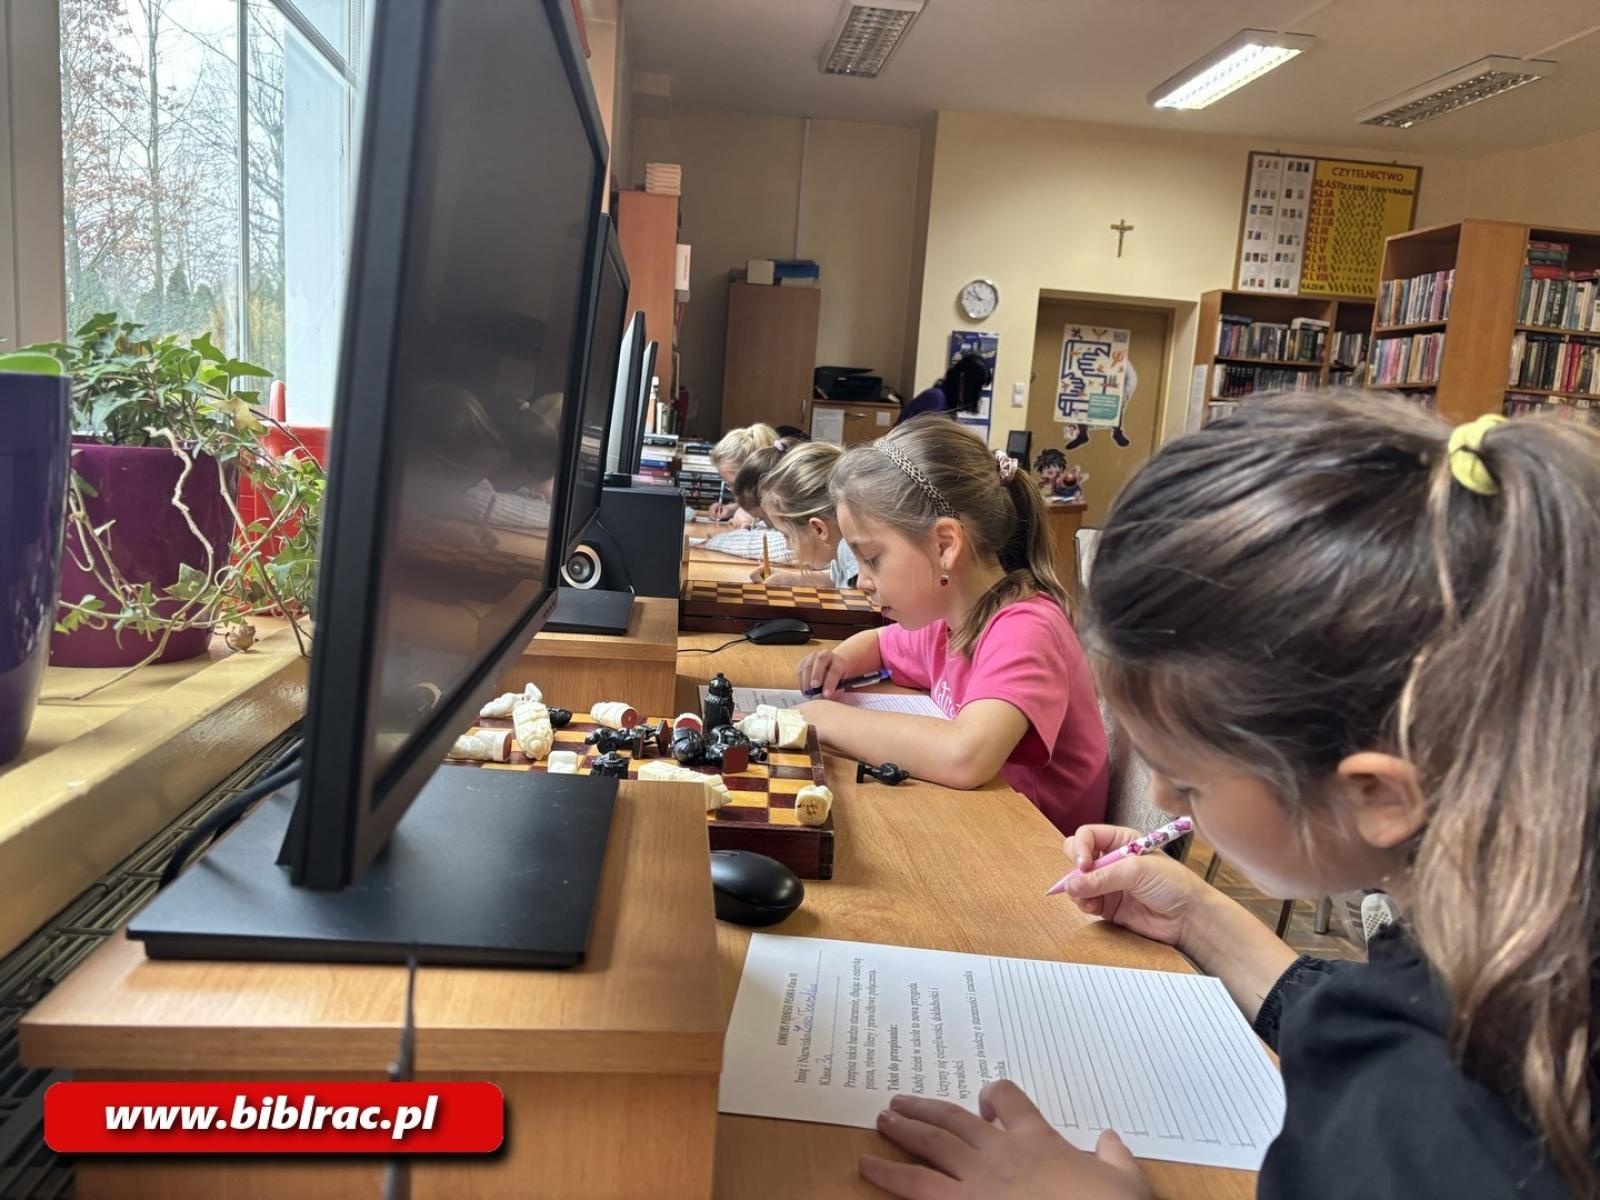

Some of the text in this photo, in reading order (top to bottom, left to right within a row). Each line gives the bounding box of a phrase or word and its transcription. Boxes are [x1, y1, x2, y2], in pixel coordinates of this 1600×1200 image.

[1332, 167, 1404, 182] CZYTELNICTWO
[912, 1007, 920, 1022] nowa
[845, 1025, 858, 1044] bardzo
[863, 1032, 878, 1047] litery
[909, 1029, 921, 1048] szkole
[845, 1045, 857, 1060] tekst
[864, 1048, 875, 1067] równe
[887, 1063, 899, 1071] do
[910, 1056, 922, 1072] dzień
[934, 1060, 949, 1069] się
[793, 1069, 810, 1083] Imię
[843, 1061, 859, 1088] Przepisz
[887, 1072, 899, 1091] Tekst
[911, 1074, 926, 1094] Każdy
[936, 1071, 950, 1096] Uczymy
